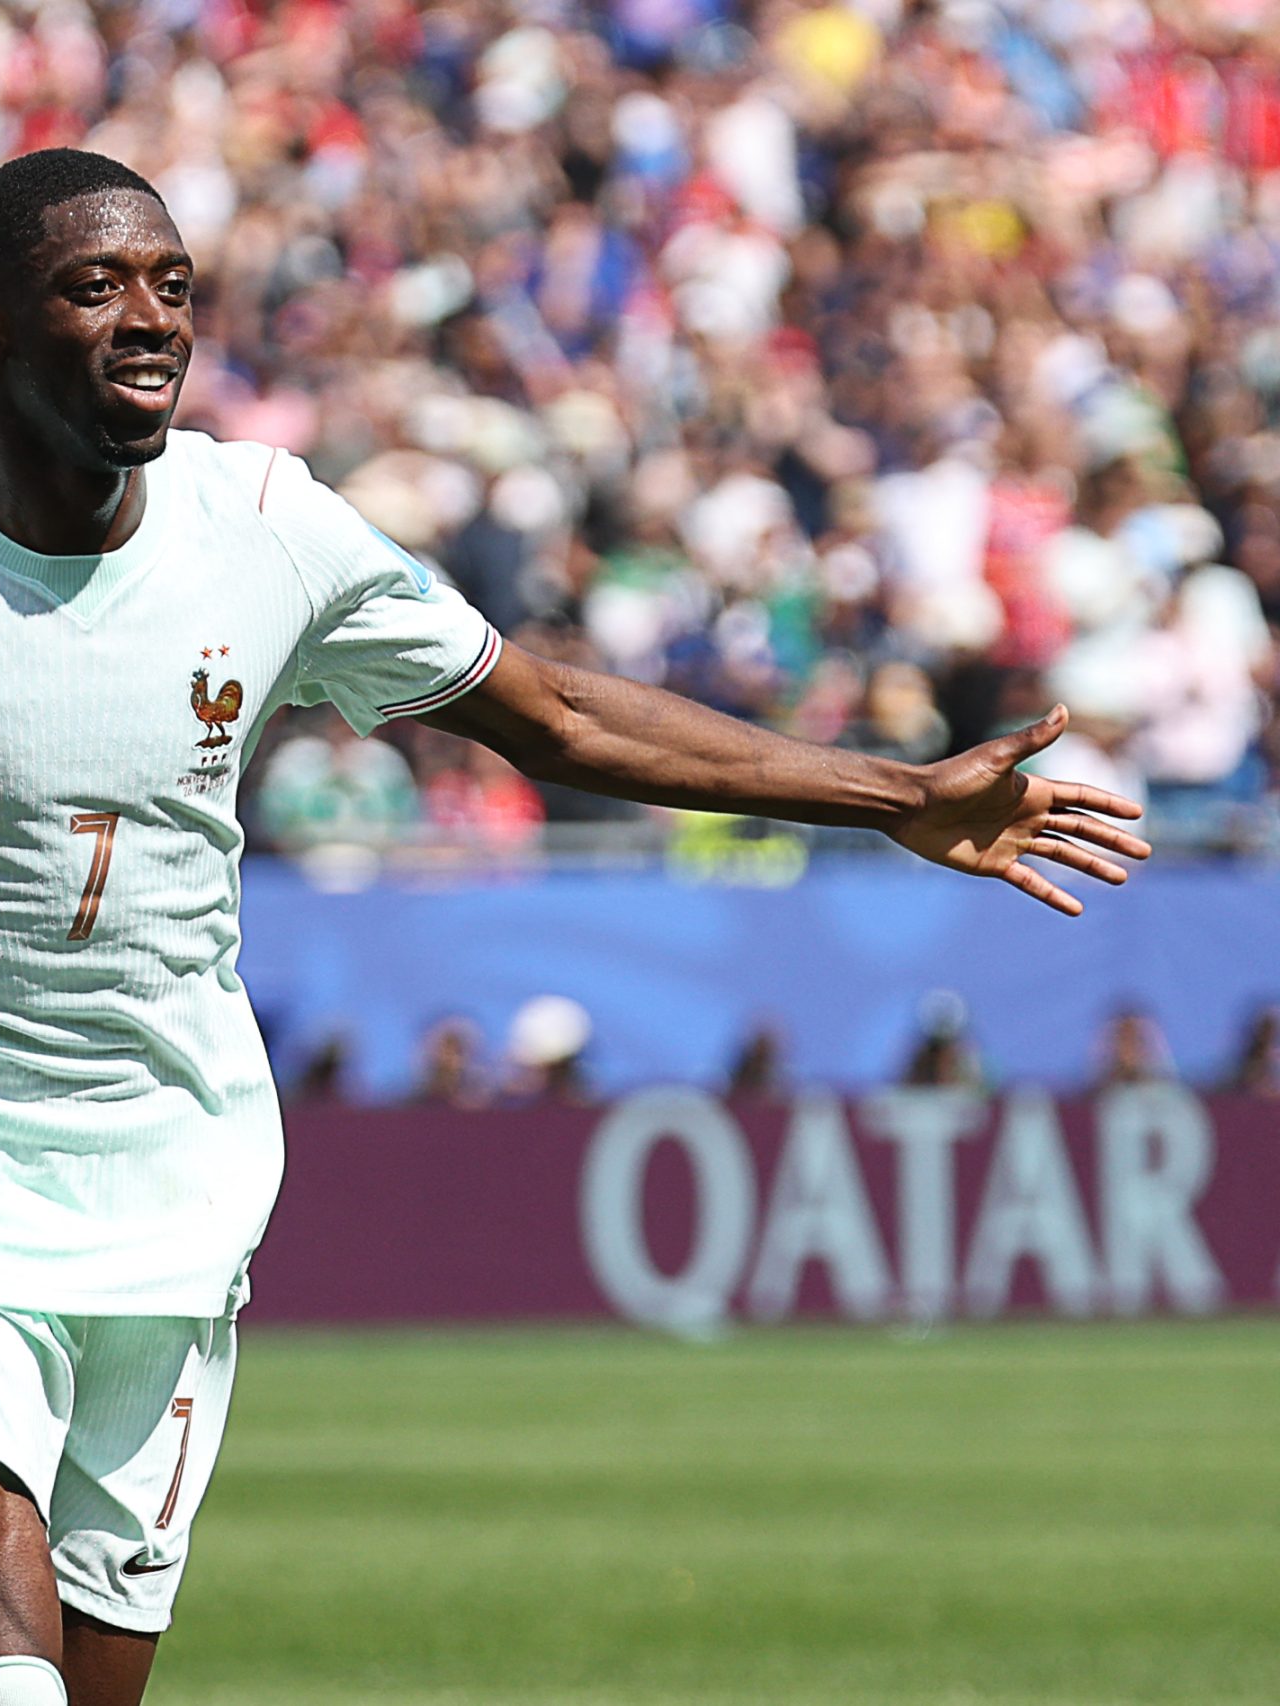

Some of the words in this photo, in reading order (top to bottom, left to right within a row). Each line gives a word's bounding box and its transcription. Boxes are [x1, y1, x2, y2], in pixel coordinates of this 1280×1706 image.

[67, 812, 120, 941] 7
[580, 1083, 1229, 1340] QATAR
[154, 1397, 194, 1530] 7
